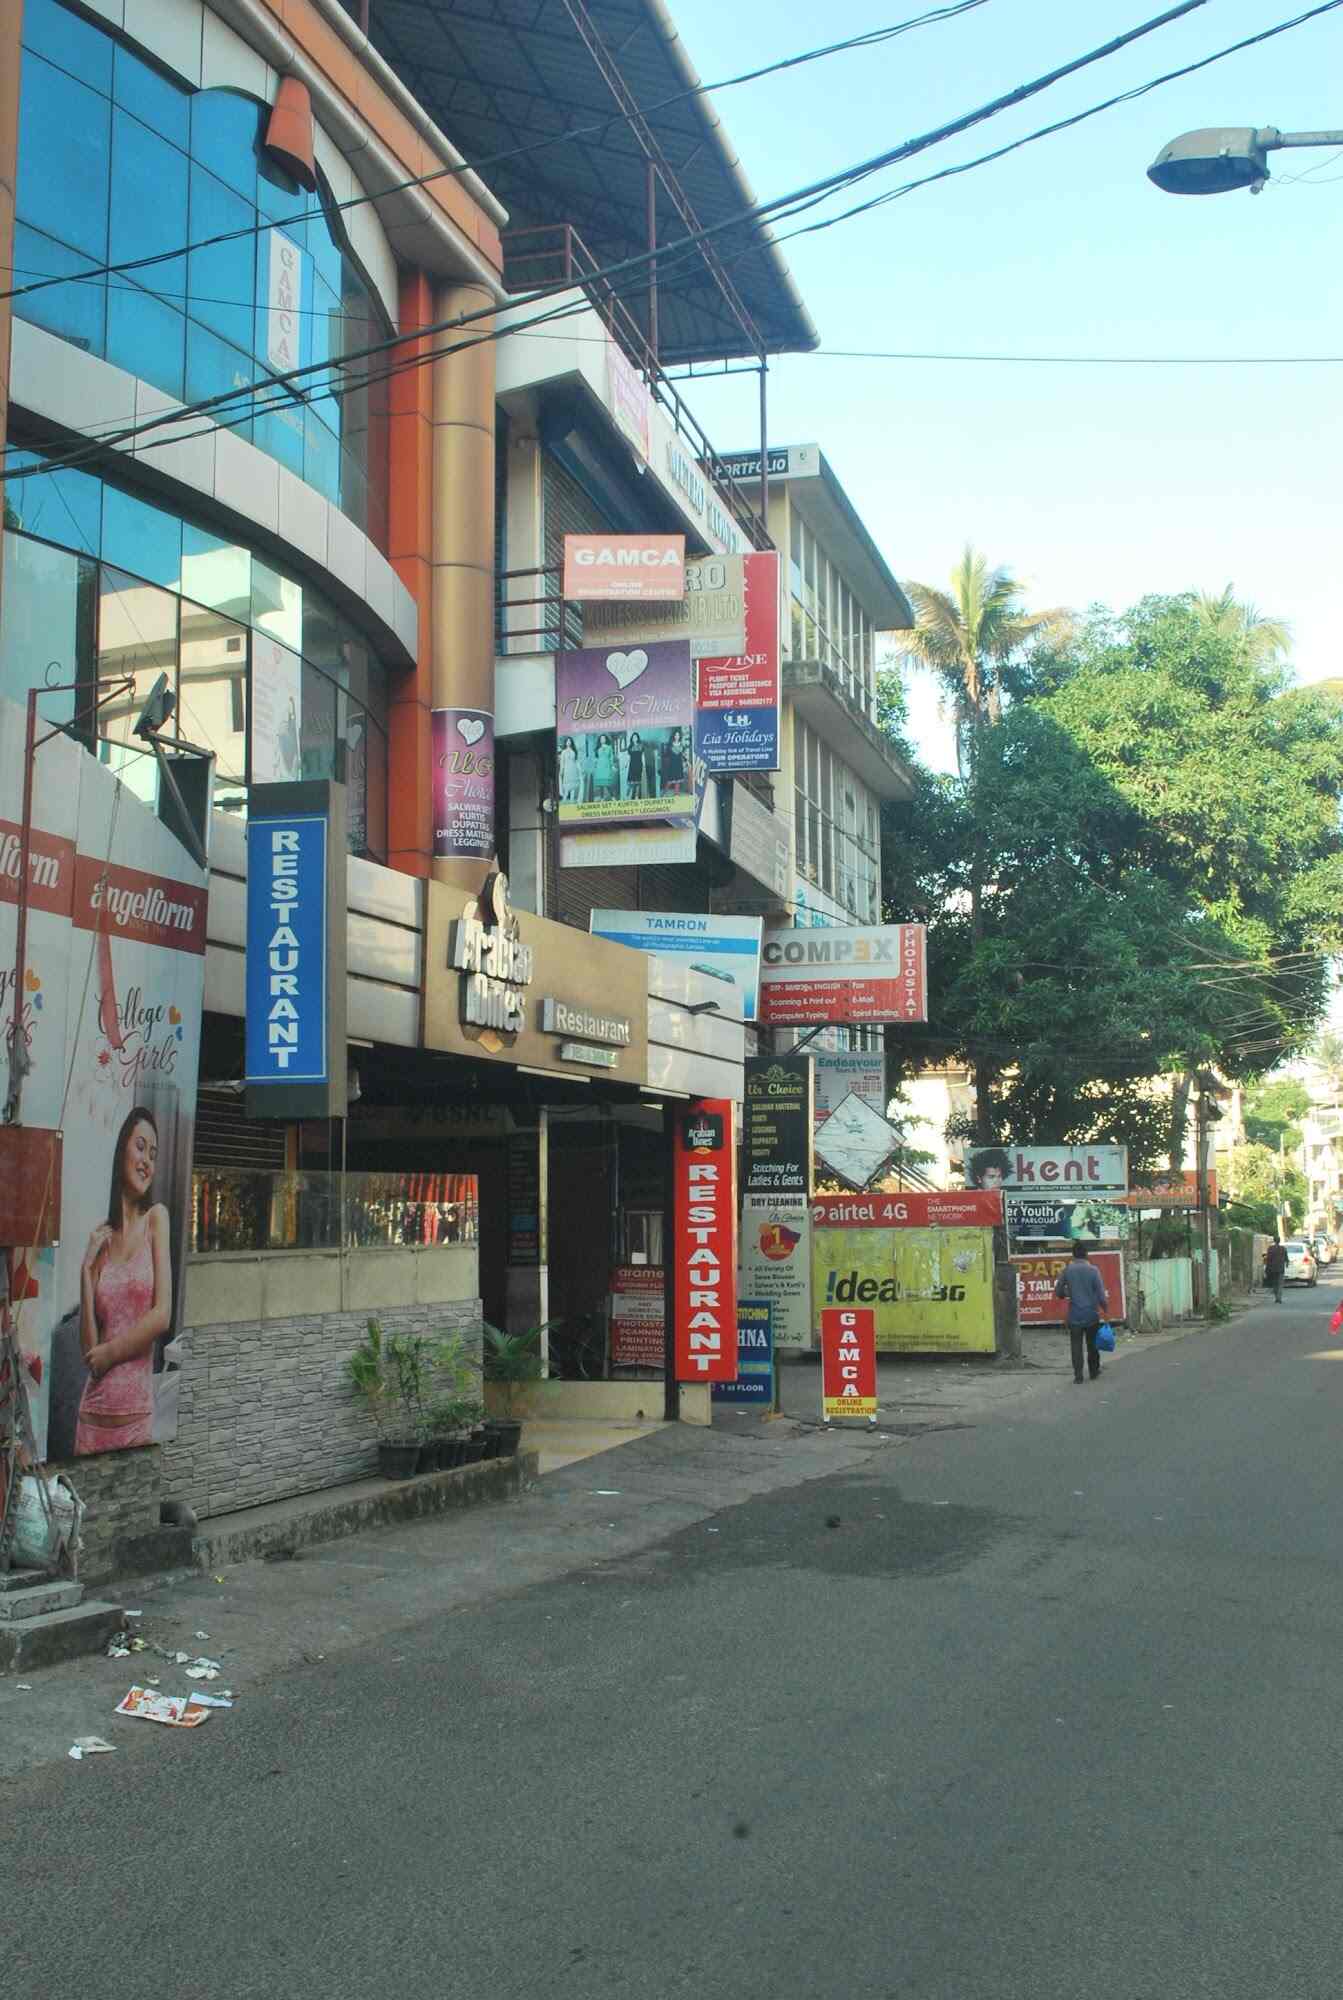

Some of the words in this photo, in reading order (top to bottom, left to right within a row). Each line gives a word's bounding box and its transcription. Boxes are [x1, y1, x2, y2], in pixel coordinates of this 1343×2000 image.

[575, 547, 680, 566] GAMCA
[724, 730, 774, 746] Holidays
[436, 829, 464, 838] DRESS
[91, 883, 195, 931] angelform
[646, 918, 707, 931] TAMRON
[268, 831, 300, 1068] RESTAURANT
[904, 929, 916, 1017] PHOTOSTAT
[769, 998, 802, 1006] Scanning
[770, 1012, 805, 1020] Computer
[556, 1004, 631, 1043] Restaurant
[114, 1031, 178, 1087] Girls
[818, 1057, 881, 1068] Endeavour
[768, 1083, 804, 1095] Choice
[752, 1163, 785, 1174] Stitching
[786, 1162, 799, 1172] For
[1016, 1153, 1100, 1182] kent
[748, 1175, 772, 1186] Ladies
[773, 1176, 780, 1186] &
[782, 1174, 804, 1186] Gents
[768, 1198, 803, 1207] CLEANING
[829, 1204, 875, 1221] airtel
[881, 1203, 908, 1220] 4G
[927, 1205, 977, 1213] SMARTPHONE
[1020, 1206, 1054, 1217] Youth
[687, 1164, 721, 1371] RESTAURANT
[838, 1312, 860, 1397] GAMCA
[736, 1384, 764, 1392] FLOOR
[837, 1399, 863, 1407] ONLINE
[826, 1407, 877, 1415] REGISTRATION
